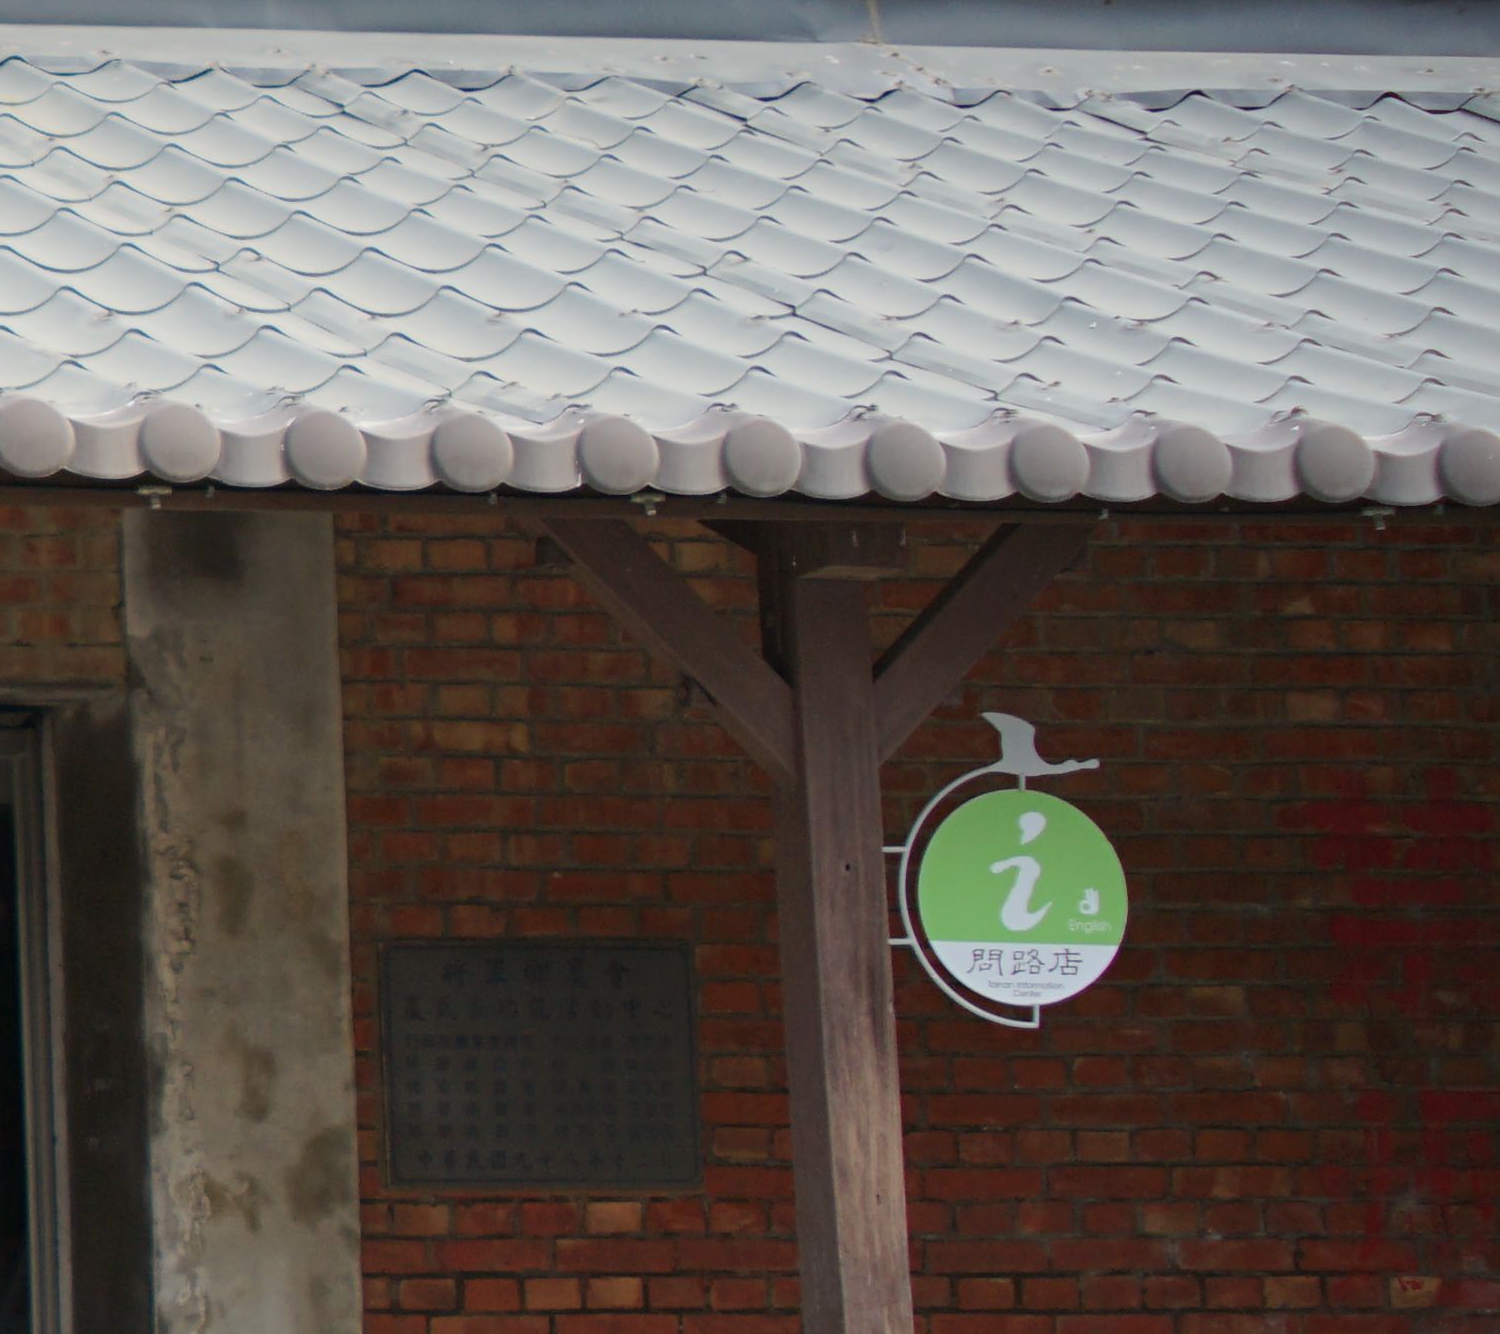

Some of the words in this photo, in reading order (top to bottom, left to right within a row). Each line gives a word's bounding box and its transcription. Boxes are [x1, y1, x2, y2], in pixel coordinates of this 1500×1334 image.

[1068, 919, 1112, 935] English
[966, 947, 1084, 978] 問路店
